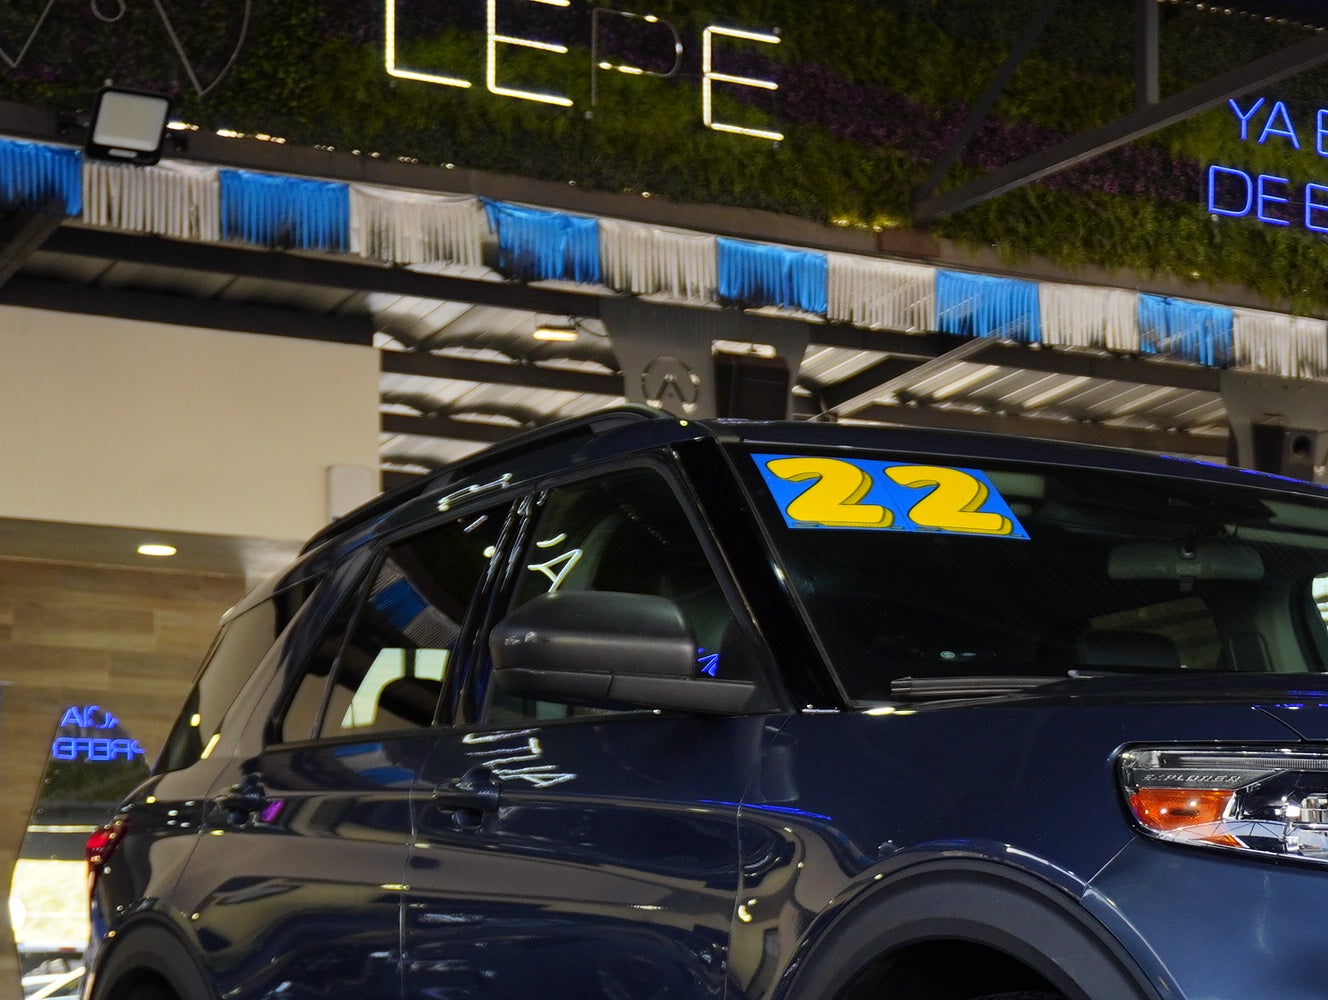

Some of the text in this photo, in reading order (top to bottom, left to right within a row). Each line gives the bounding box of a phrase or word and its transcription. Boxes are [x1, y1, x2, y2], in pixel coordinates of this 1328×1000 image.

[385, 0, 785, 141] LEPE
[1228, 96, 1301, 151] YA
[1208, 164, 1291, 227] DE
[765, 456, 1014, 535] 22
[1142, 773, 1243, 784] EXPLORER
